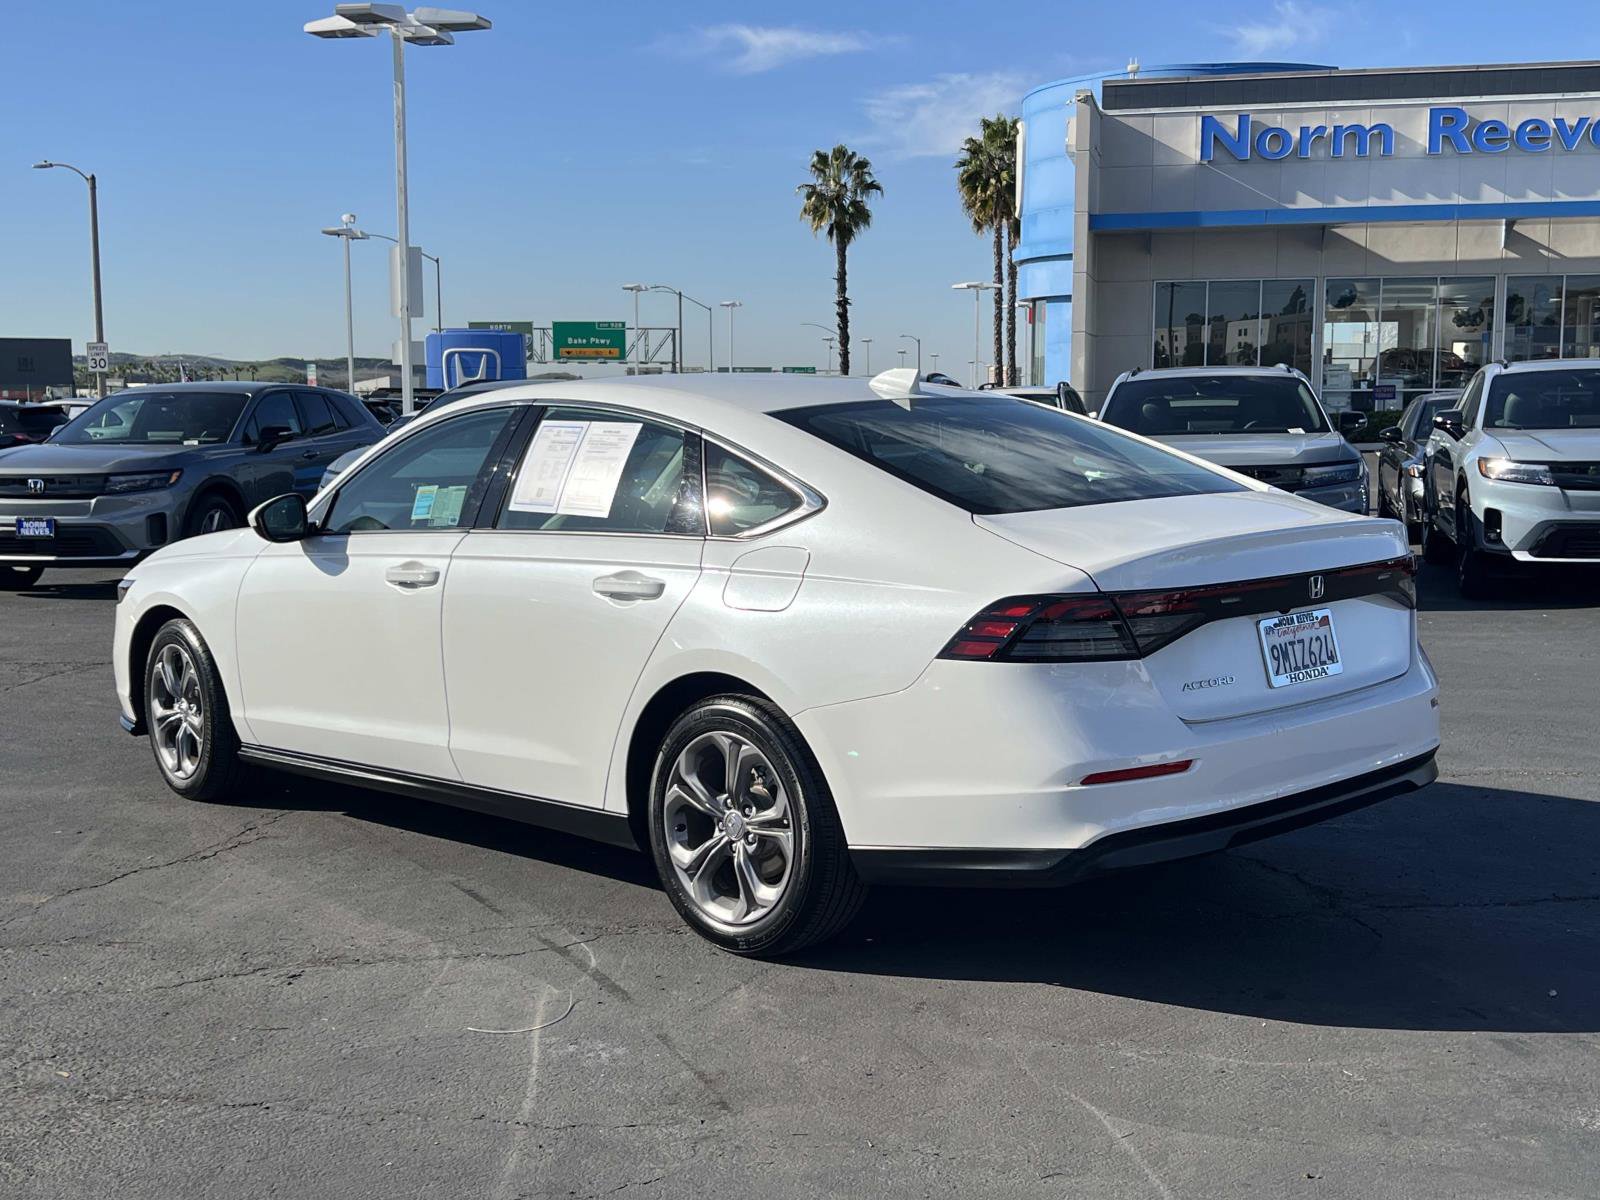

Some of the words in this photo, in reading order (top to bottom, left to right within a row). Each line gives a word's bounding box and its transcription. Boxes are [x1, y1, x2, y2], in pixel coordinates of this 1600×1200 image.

[1200, 113, 1395, 162] Norm
[567, 337, 587, 345] Bake
[590, 337, 611, 346] Pkwy
[90, 358, 107, 369] 30
[20, 527, 50, 536] REEVES
[1278, 615, 1295, 627] NORM
[1296, 612, 1315, 624] REEVES
[1270, 634, 1335, 676] 9MIZ624
[1182, 675, 1236, 692] ACCORD
